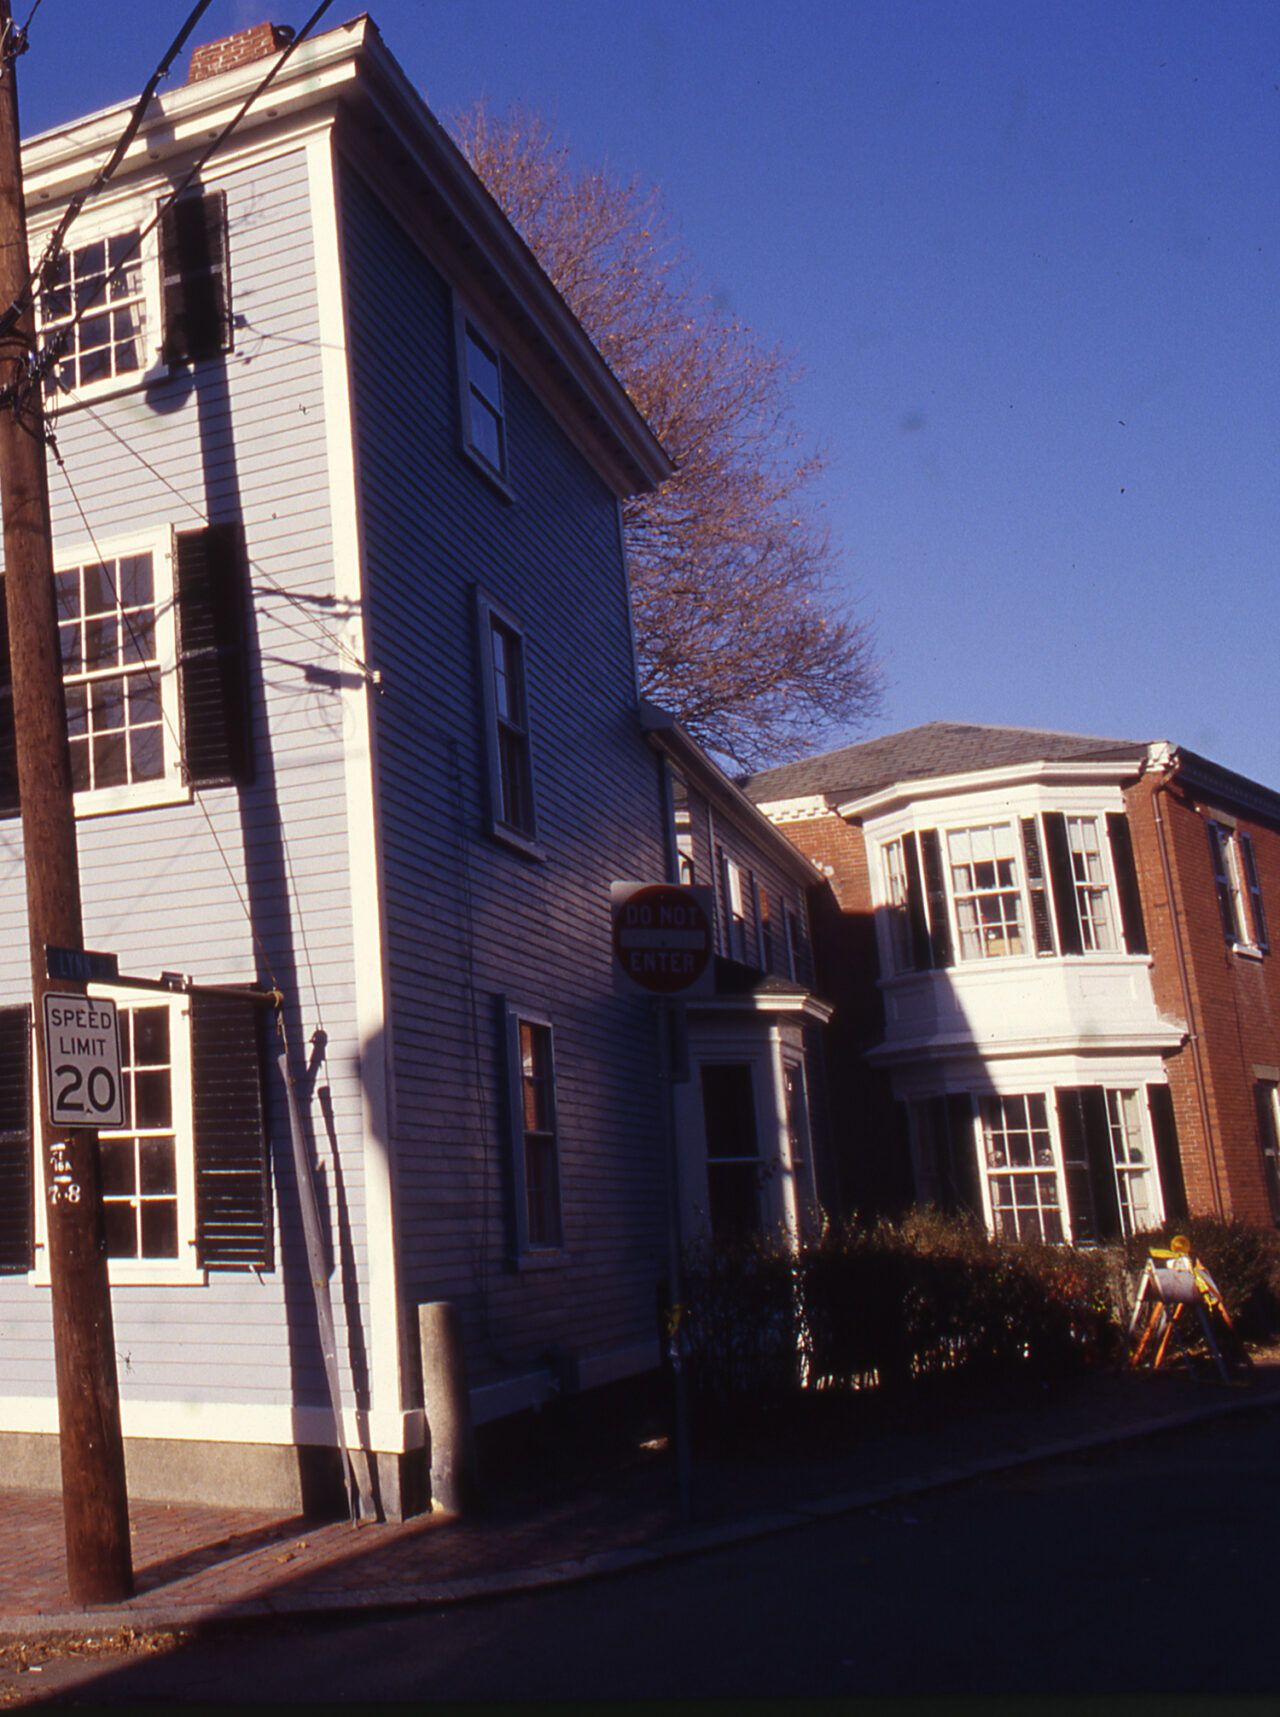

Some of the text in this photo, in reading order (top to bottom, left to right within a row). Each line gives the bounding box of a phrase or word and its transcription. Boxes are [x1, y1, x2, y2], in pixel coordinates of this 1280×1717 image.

[626, 904, 697, 927] DO NOT
[629, 951, 695, 974] ENTER
[51, 1008, 112, 1029] SPEED
[60, 1036, 106, 1056] LIMIT
[55, 1064, 116, 1113] 20
